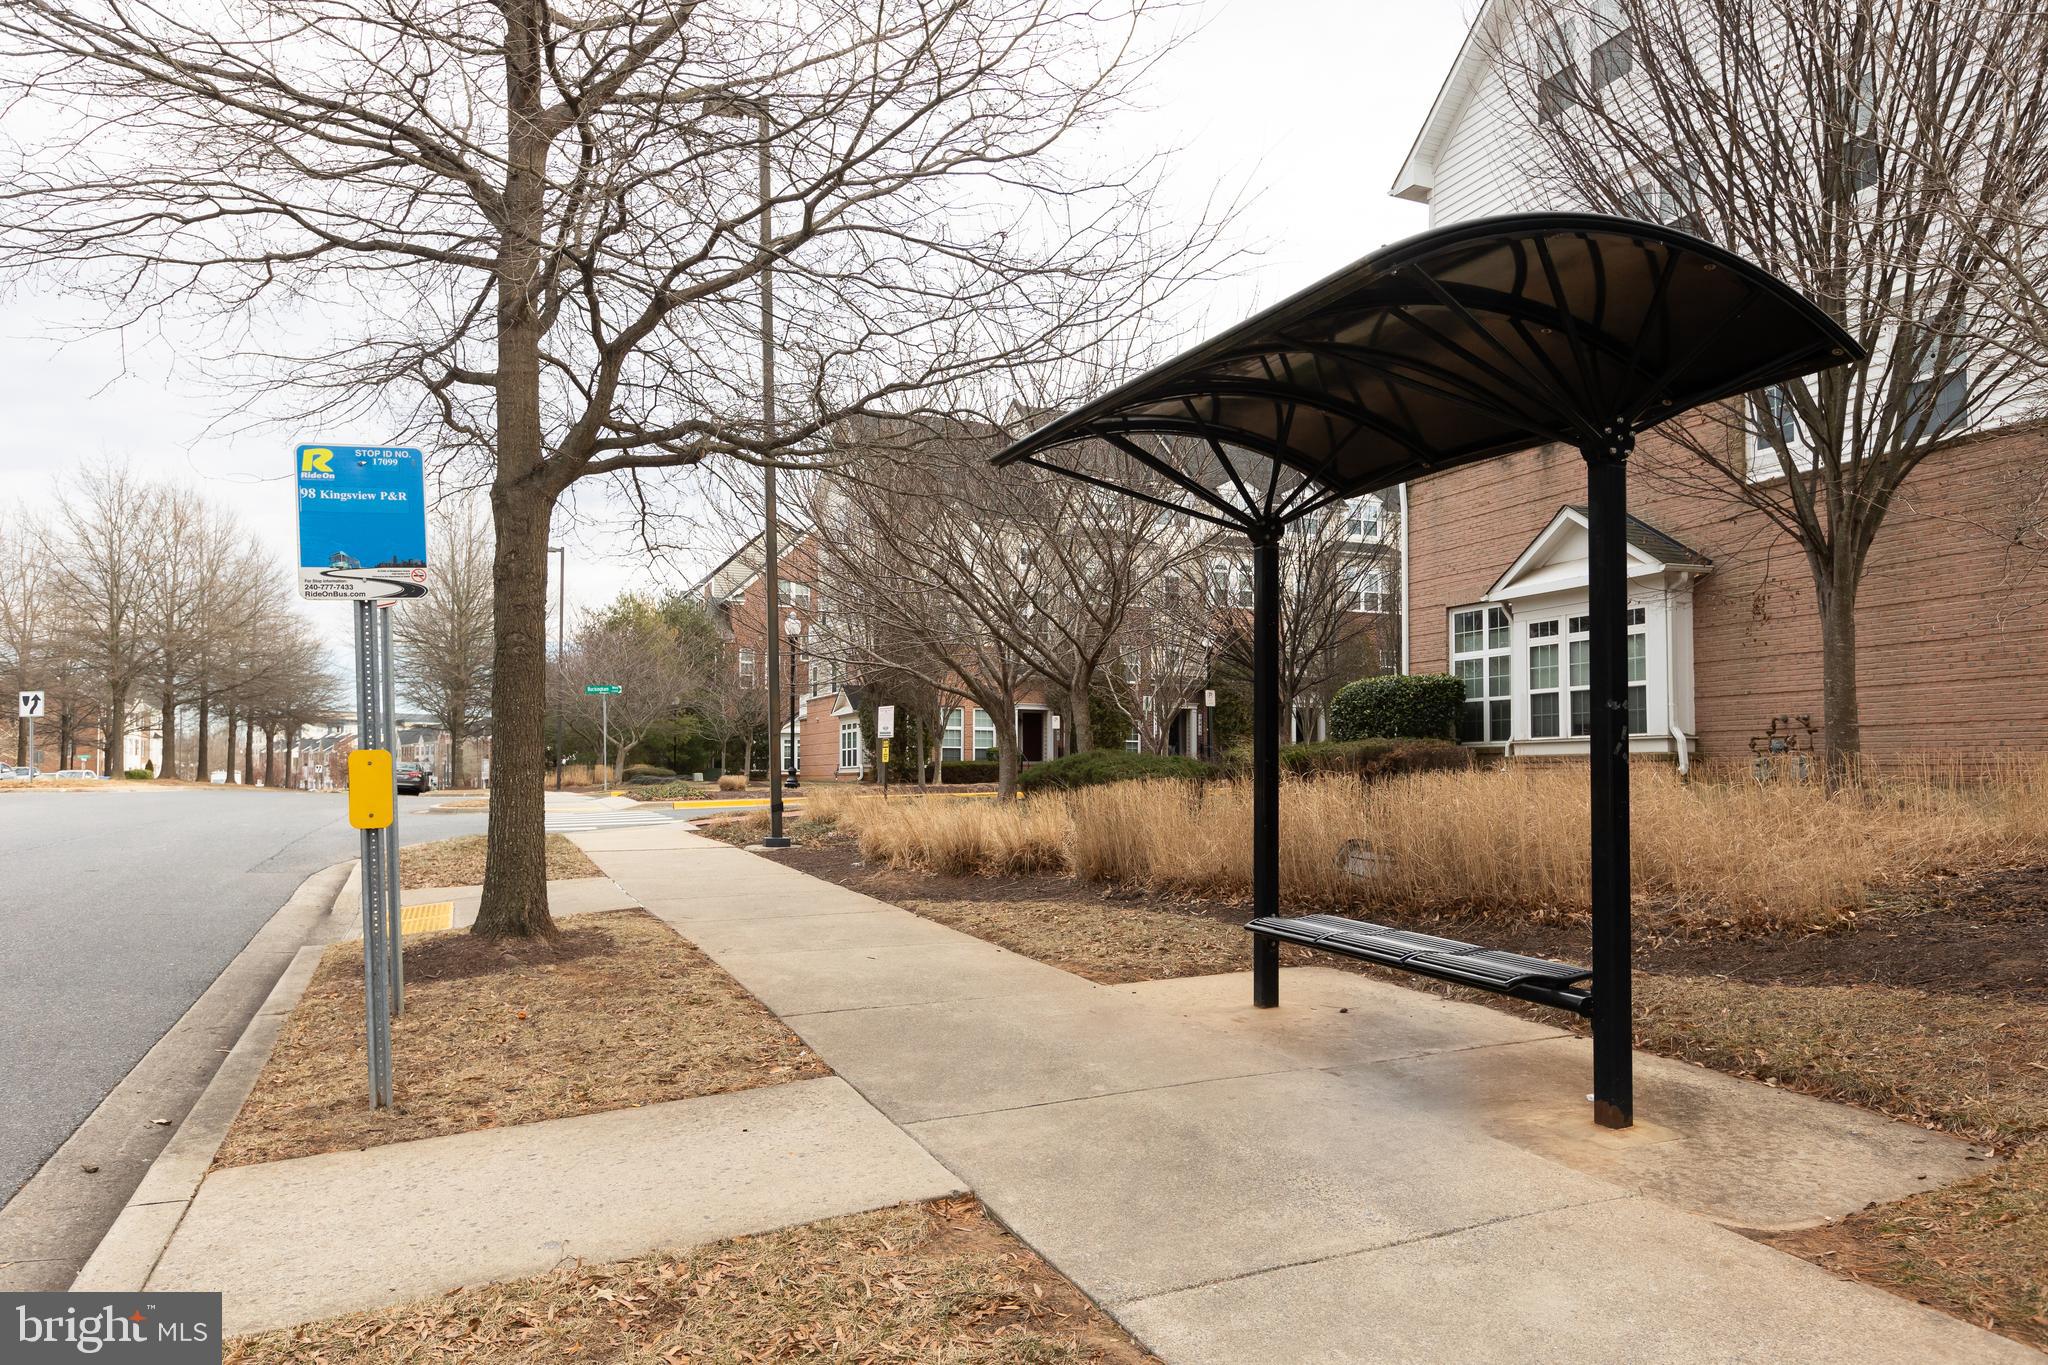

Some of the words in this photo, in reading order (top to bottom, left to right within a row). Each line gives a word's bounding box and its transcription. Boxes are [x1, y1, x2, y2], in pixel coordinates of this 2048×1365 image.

[383, 450, 393, 458] ID
[395, 451, 411, 459] NO.
[301, 448, 334, 473] R
[372, 458, 399, 466] 17099
[300, 487, 316, 499] 98
[320, 490, 377, 501] Kingsview
[380, 491, 408, 501] P&R
